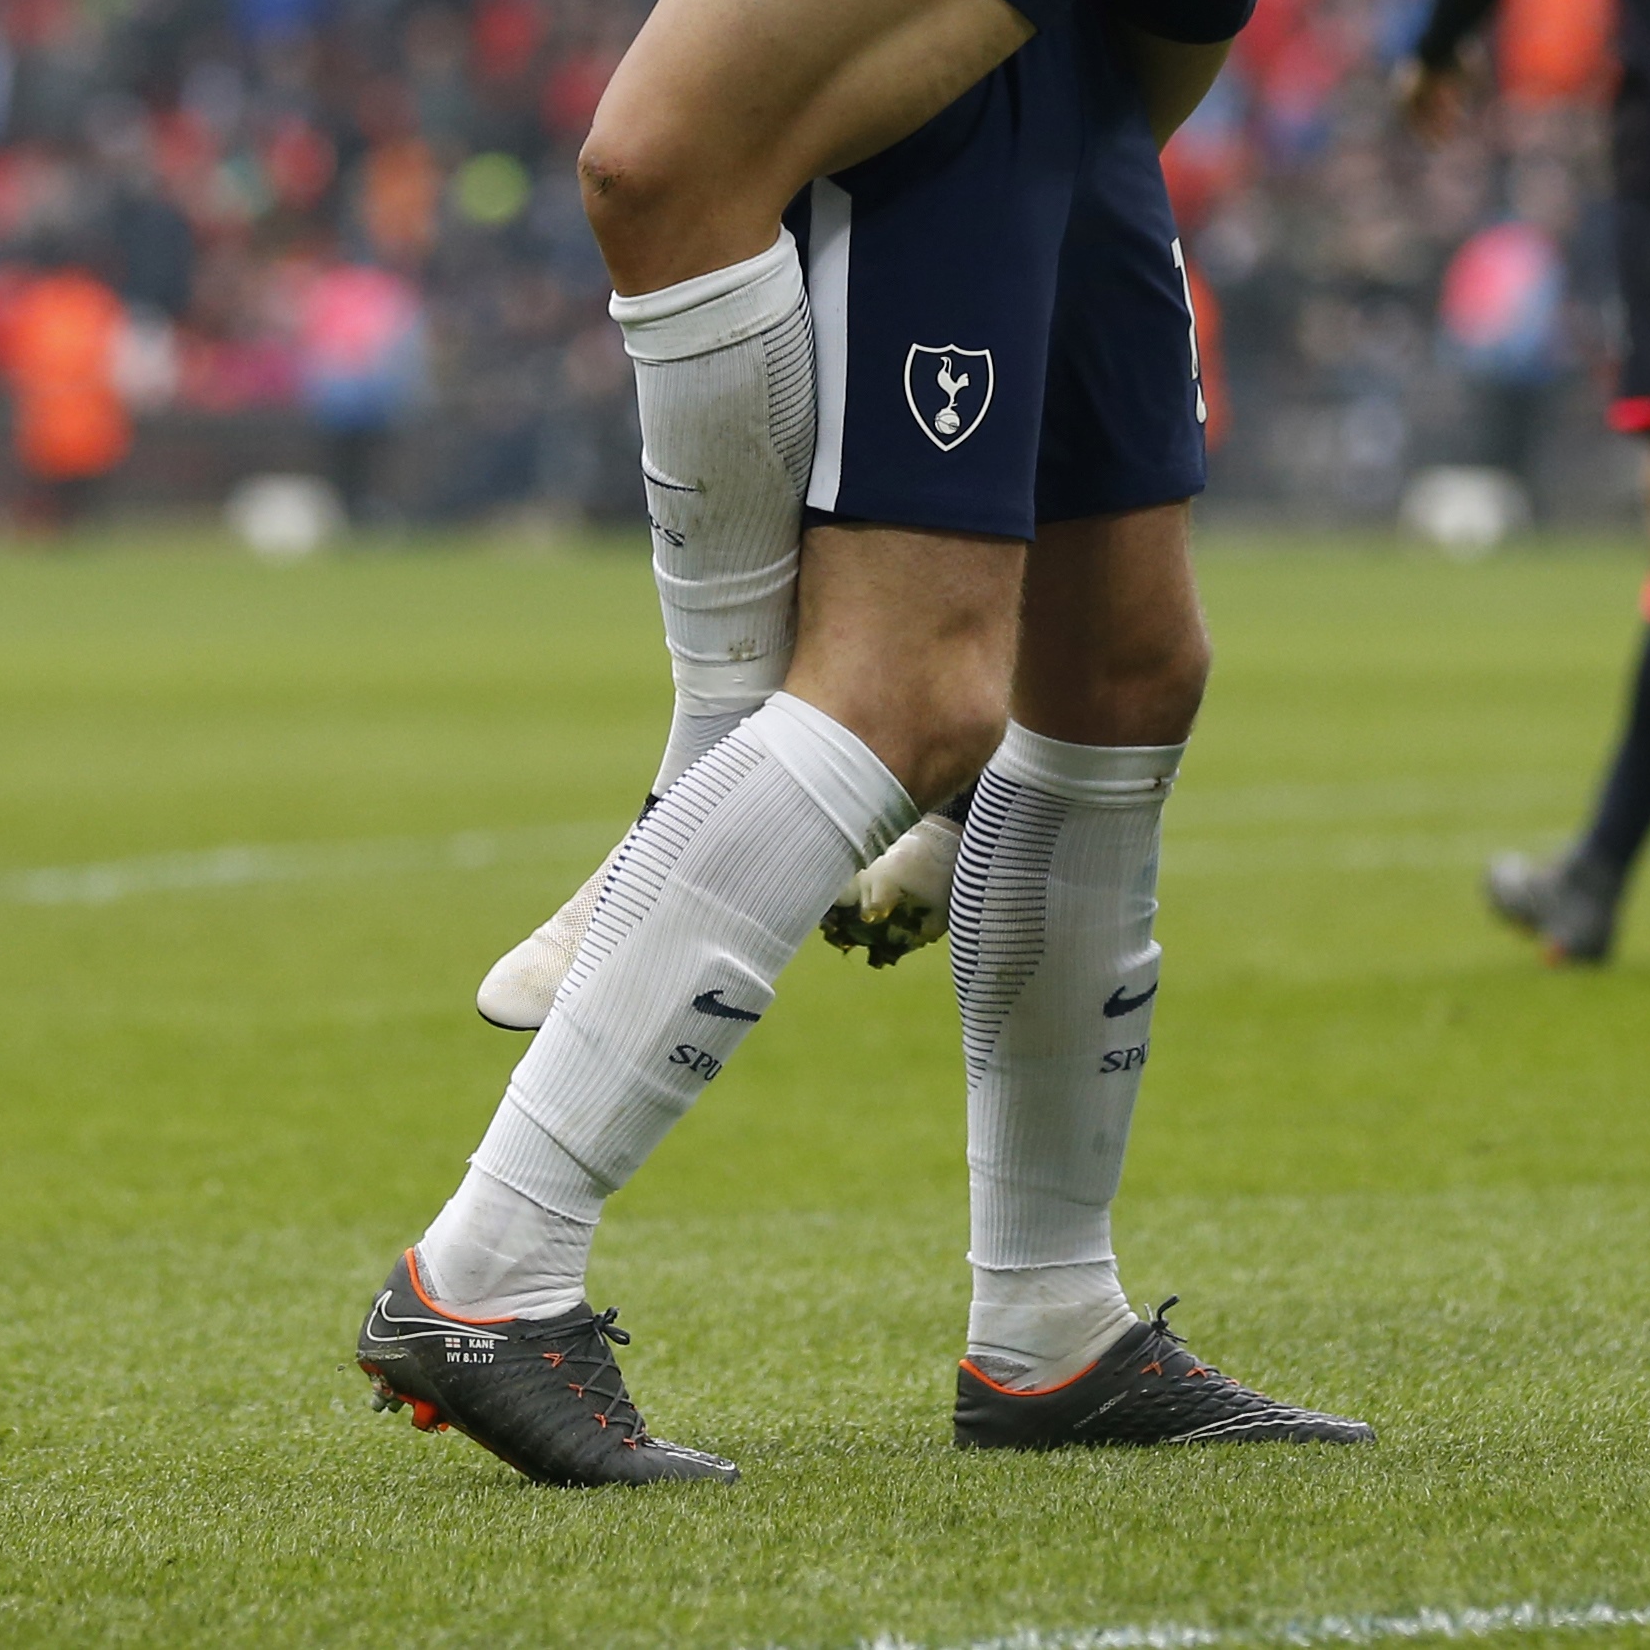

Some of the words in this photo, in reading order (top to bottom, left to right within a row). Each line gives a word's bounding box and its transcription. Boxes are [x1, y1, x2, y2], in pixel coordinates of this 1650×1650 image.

[468, 1338, 495, 1350] KANE
[446, 1352, 461, 1363] IVY
[463, 1352, 495, 1364] 8.1.17
